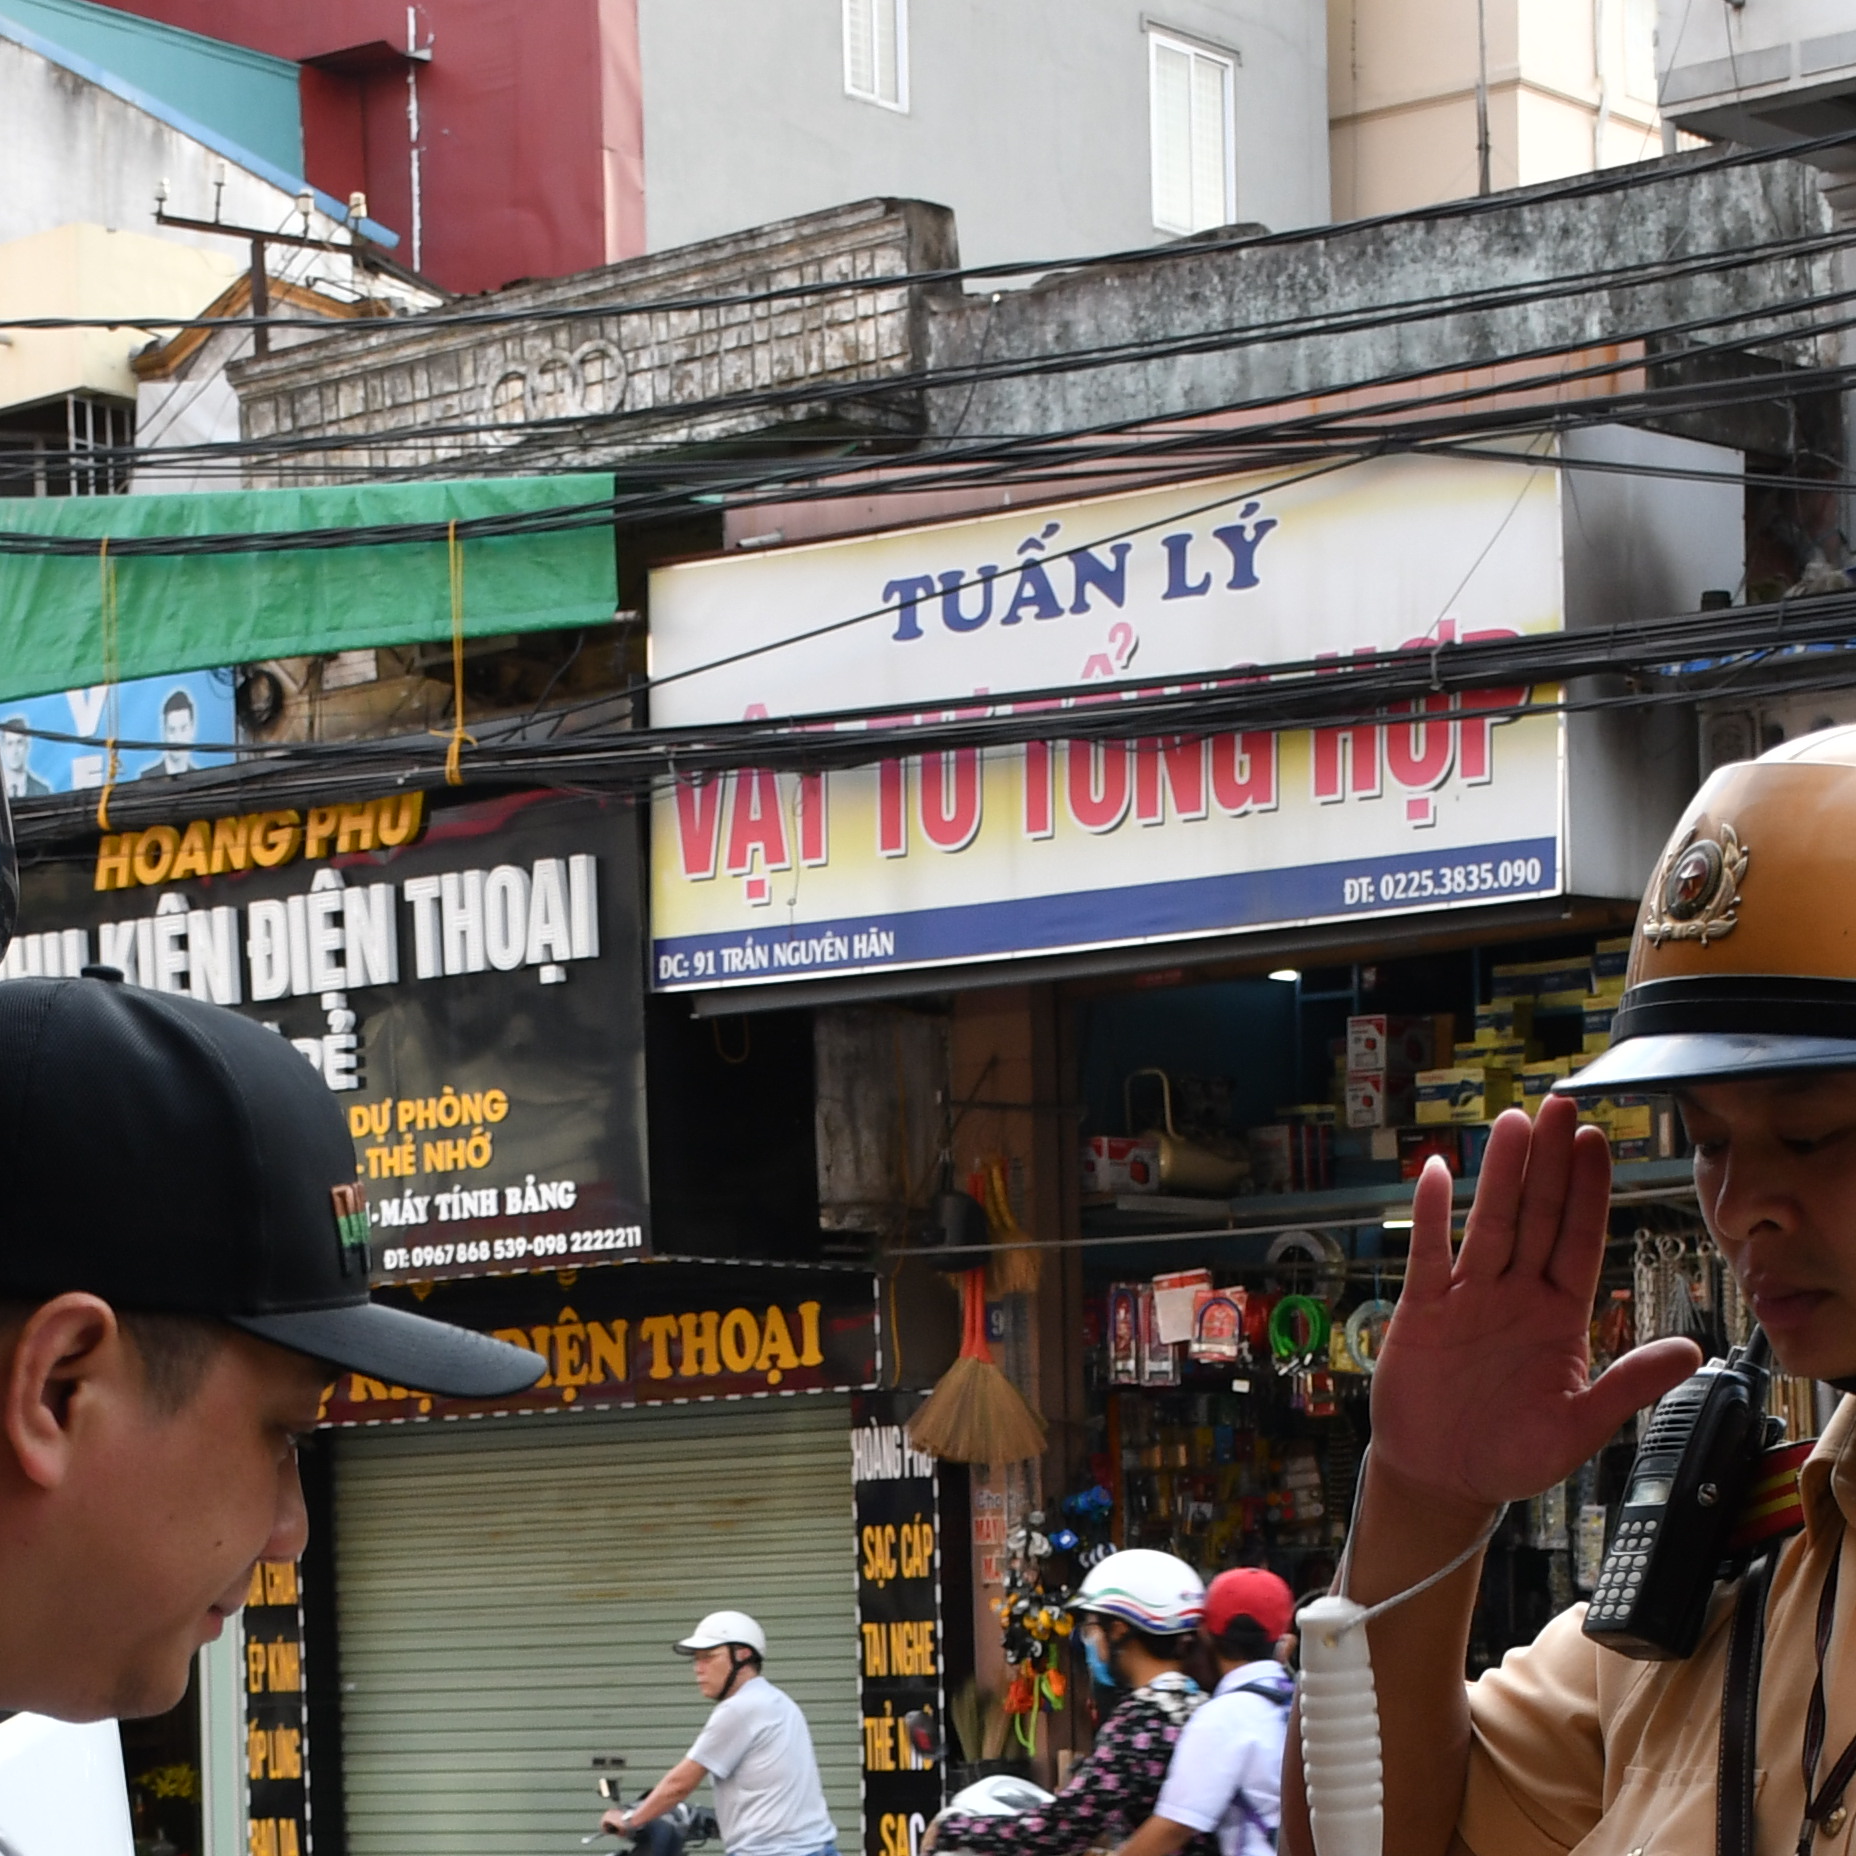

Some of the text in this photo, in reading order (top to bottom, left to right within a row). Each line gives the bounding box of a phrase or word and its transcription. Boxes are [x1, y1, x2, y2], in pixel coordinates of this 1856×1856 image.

[882, 502, 1277, 641] TUẤN LÝ
[1344, 857, 1542, 905] ĐT: 0225.3835.090
[248, 869, 399, 1010] ĐIỆN
[405, 854, 599, 984] THOẠI
[659, 952, 690, 979] ĐC:
[693, 950, 717, 975] 91
[773, 930, 848, 967] NGUYÊN
[852, 926, 895, 960] HÃN
[350, 1085, 509, 1142] DỰ PHÒNG
[366, 1126, 492, 1179] THẺ NHỚ
[435, 1184, 499, 1220] TÍNH
[505, 1174, 576, 1217] BẢNG
[639, 1300, 823, 1385] THOẠI
[862, 1523, 897, 1589] SẠC
[900, 1512, 934, 1579] CÁP
[861, 1620, 937, 1677] TAI NGHE
